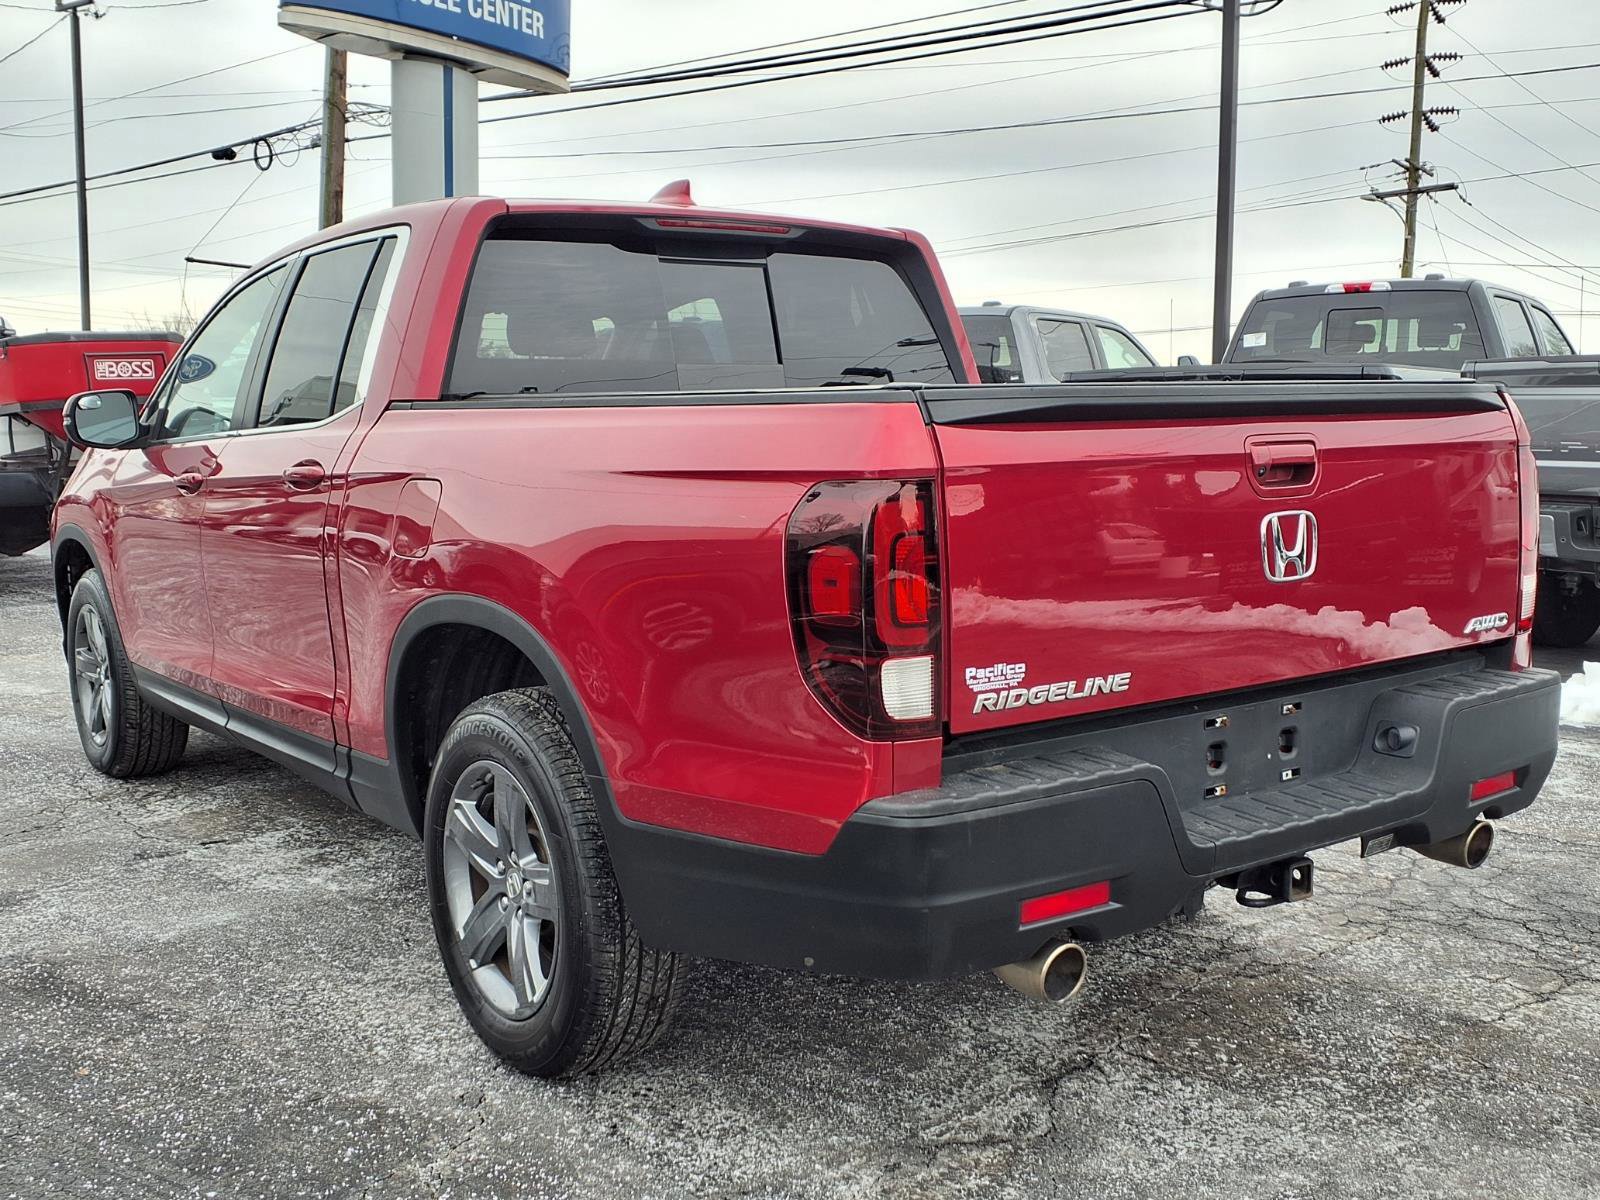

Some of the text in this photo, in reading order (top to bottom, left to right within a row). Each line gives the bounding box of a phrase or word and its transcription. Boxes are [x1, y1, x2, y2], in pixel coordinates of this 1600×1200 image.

[467, 0, 545, 40] CENTER
[96, 361, 106, 377] THE
[105, 361, 153, 377] BOSS
[1463, 611, 1509, 634] AWD
[965, 662, 1026, 681] Pacifico
[972, 671, 1133, 715] RIDGELINE
